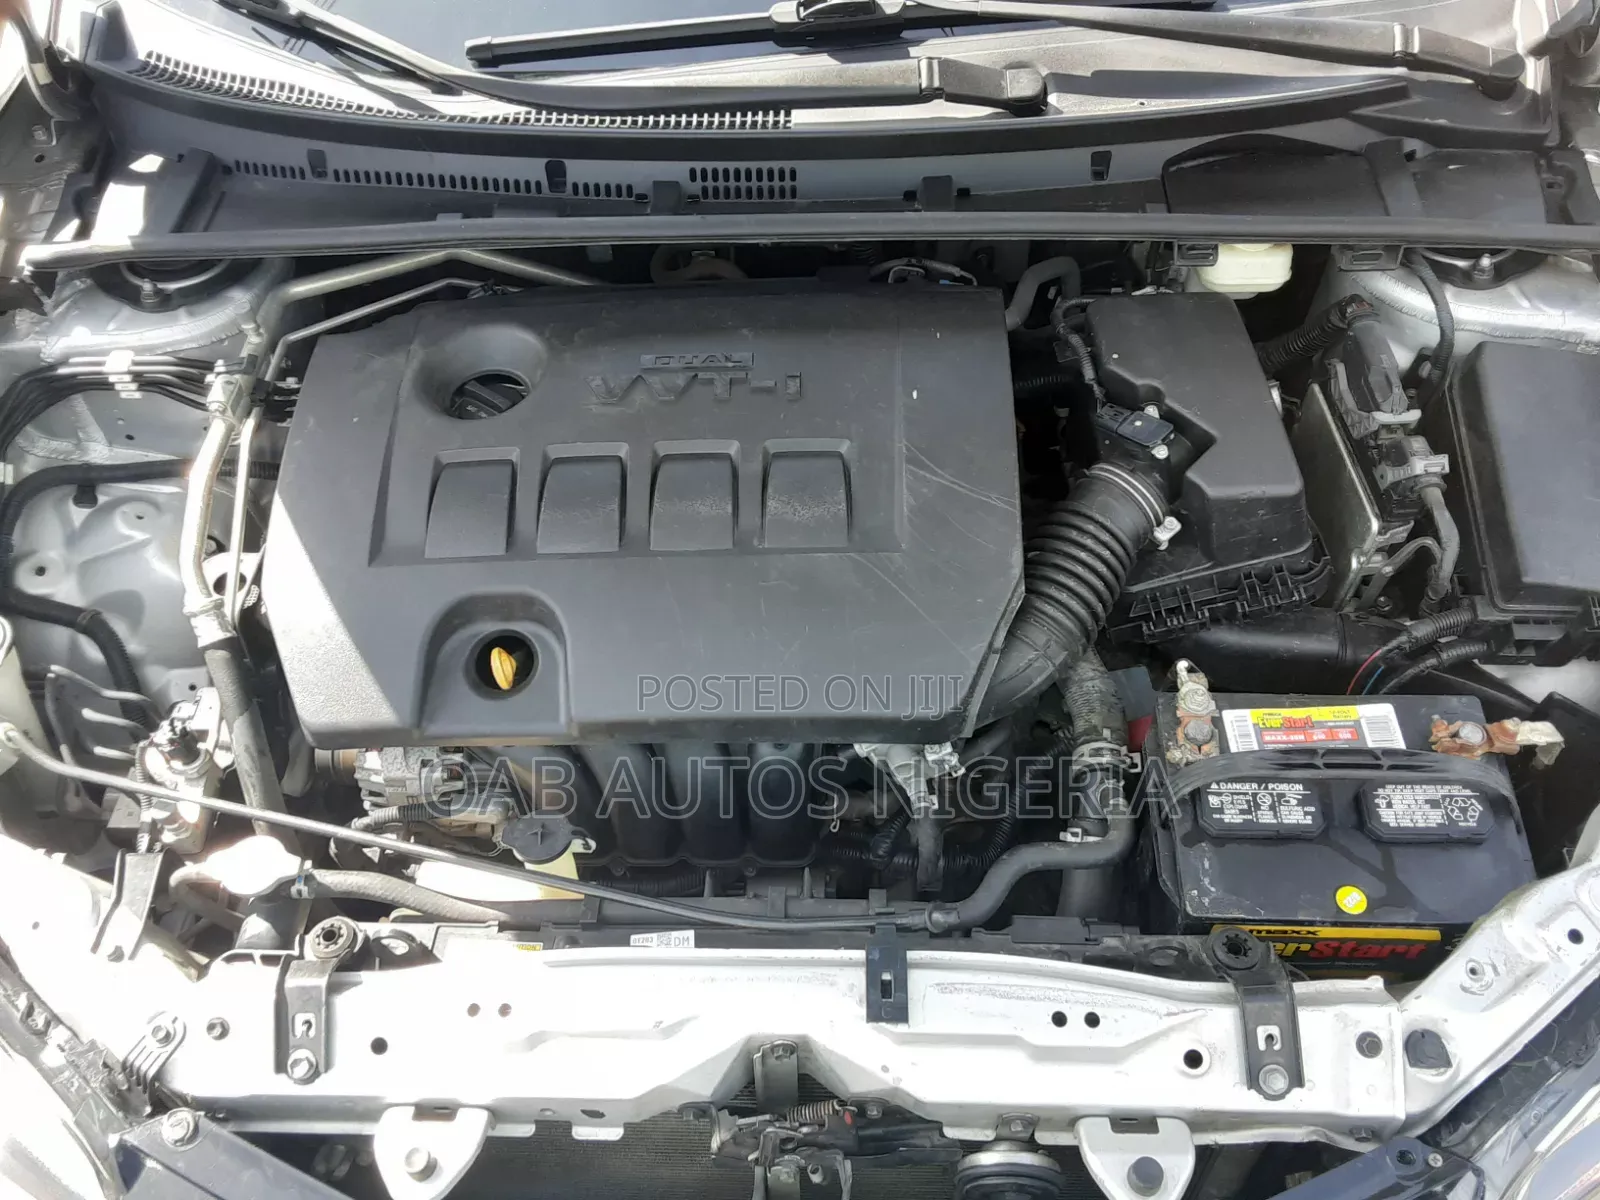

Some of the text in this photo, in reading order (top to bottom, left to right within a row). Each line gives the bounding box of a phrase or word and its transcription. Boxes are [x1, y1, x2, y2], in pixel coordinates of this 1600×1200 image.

[645, 354, 751, 367] DUAL
[1257, 715, 1315, 728] EverStart
[1220, 782, 1259, 790] DANGER
[1267, 783, 1304, 791] POISON
[1249, 928, 1322, 936] maxx
[673, 935, 690, 947] DM
[1272, 941, 1426, 959] erStart
